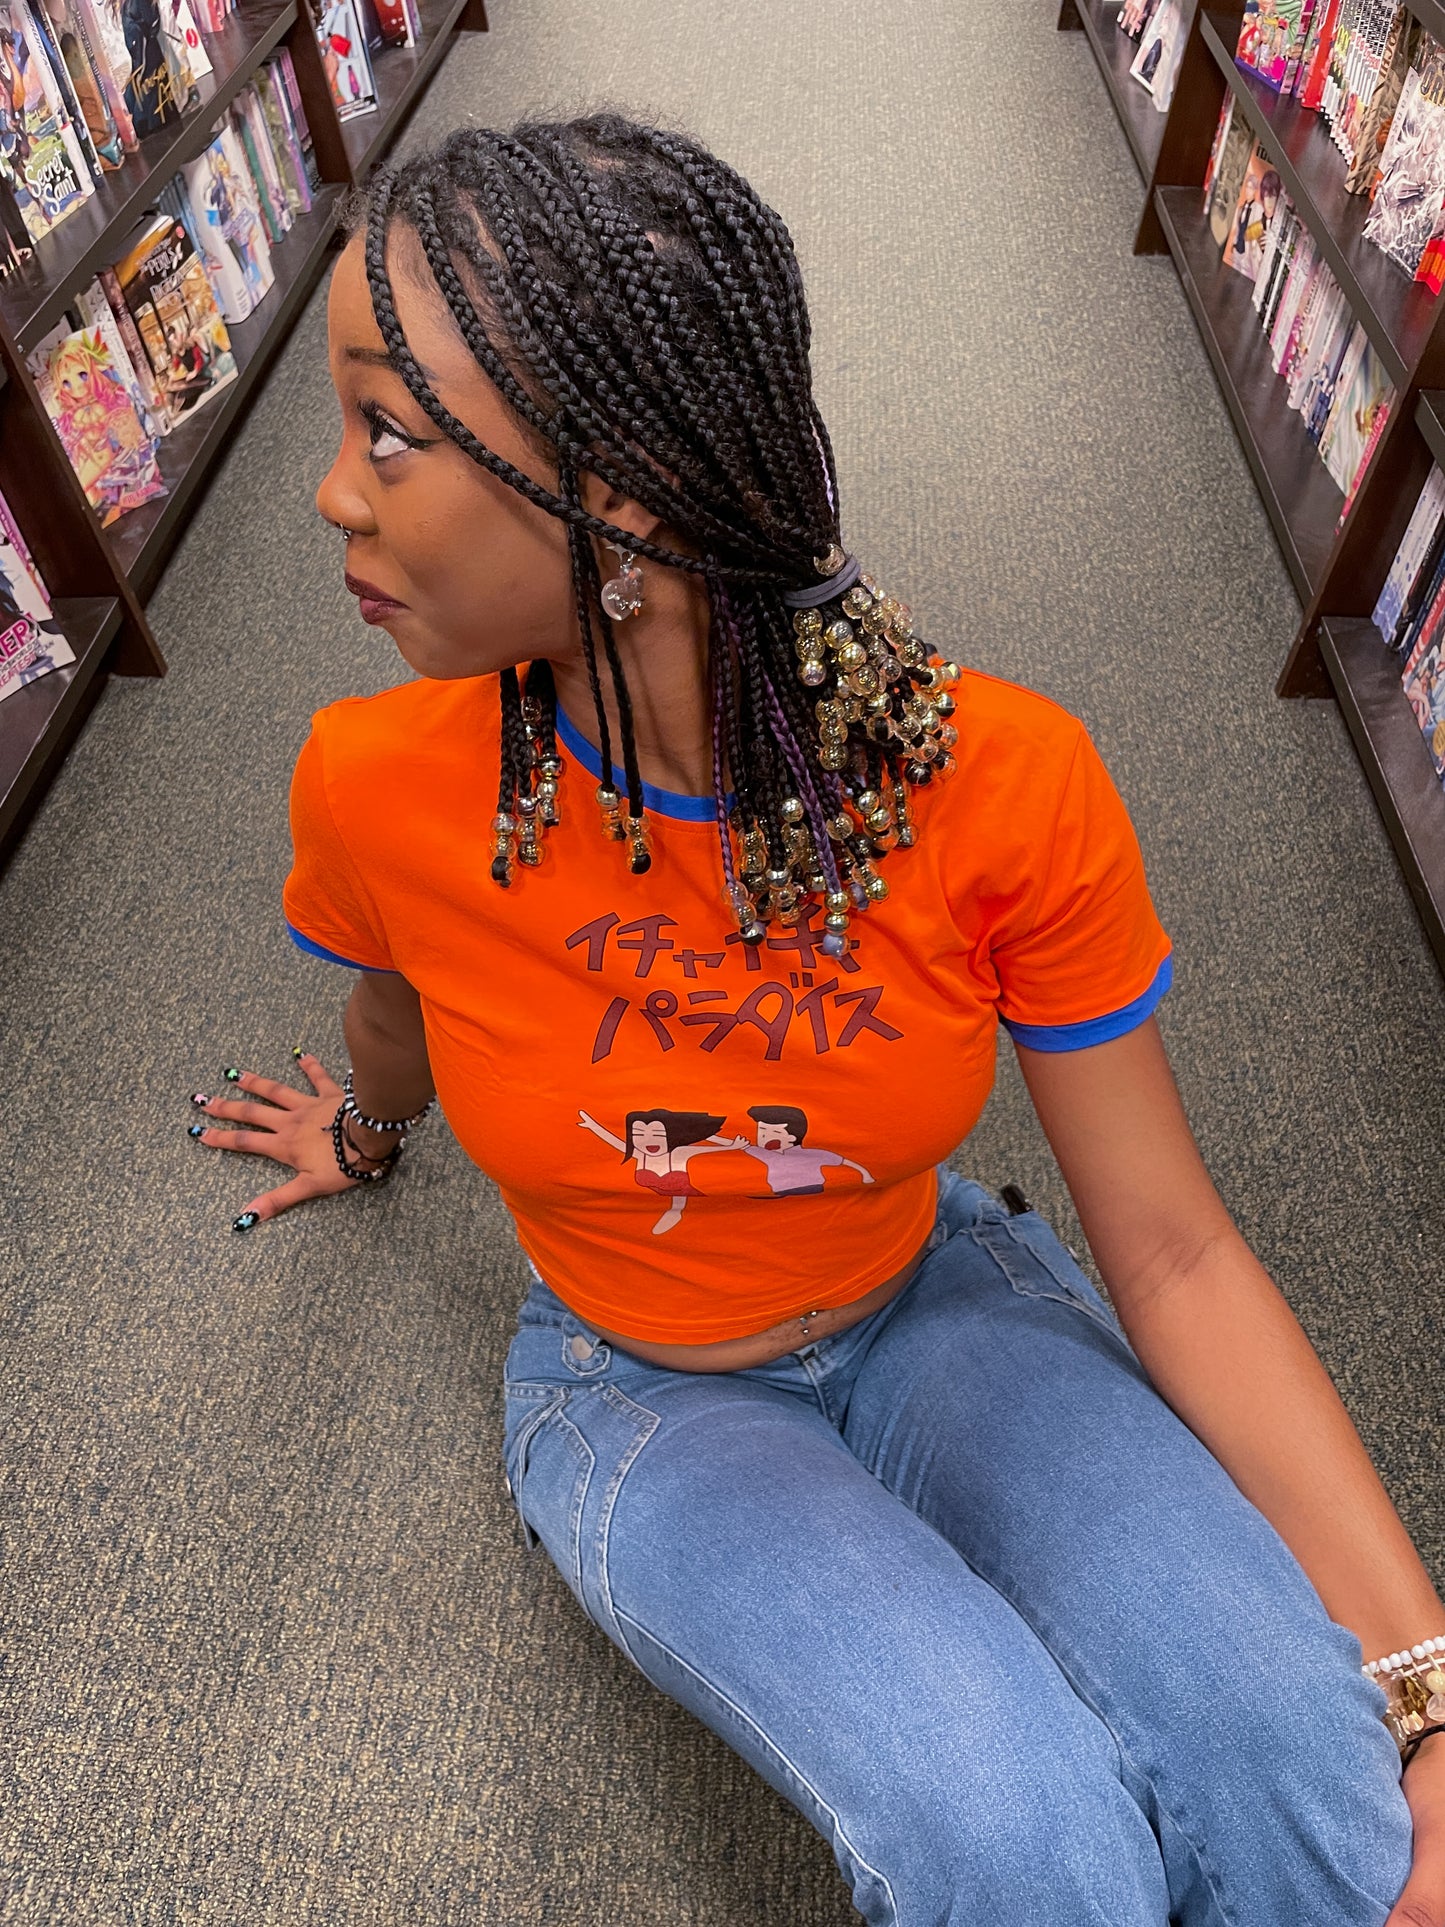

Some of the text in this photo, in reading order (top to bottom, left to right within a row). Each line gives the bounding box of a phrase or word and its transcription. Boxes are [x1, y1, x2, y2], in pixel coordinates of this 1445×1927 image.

[25, 147, 65, 198] Secret
[43, 166, 76, 216] Saint
[591, 972, 905, 1064] パラダイス
